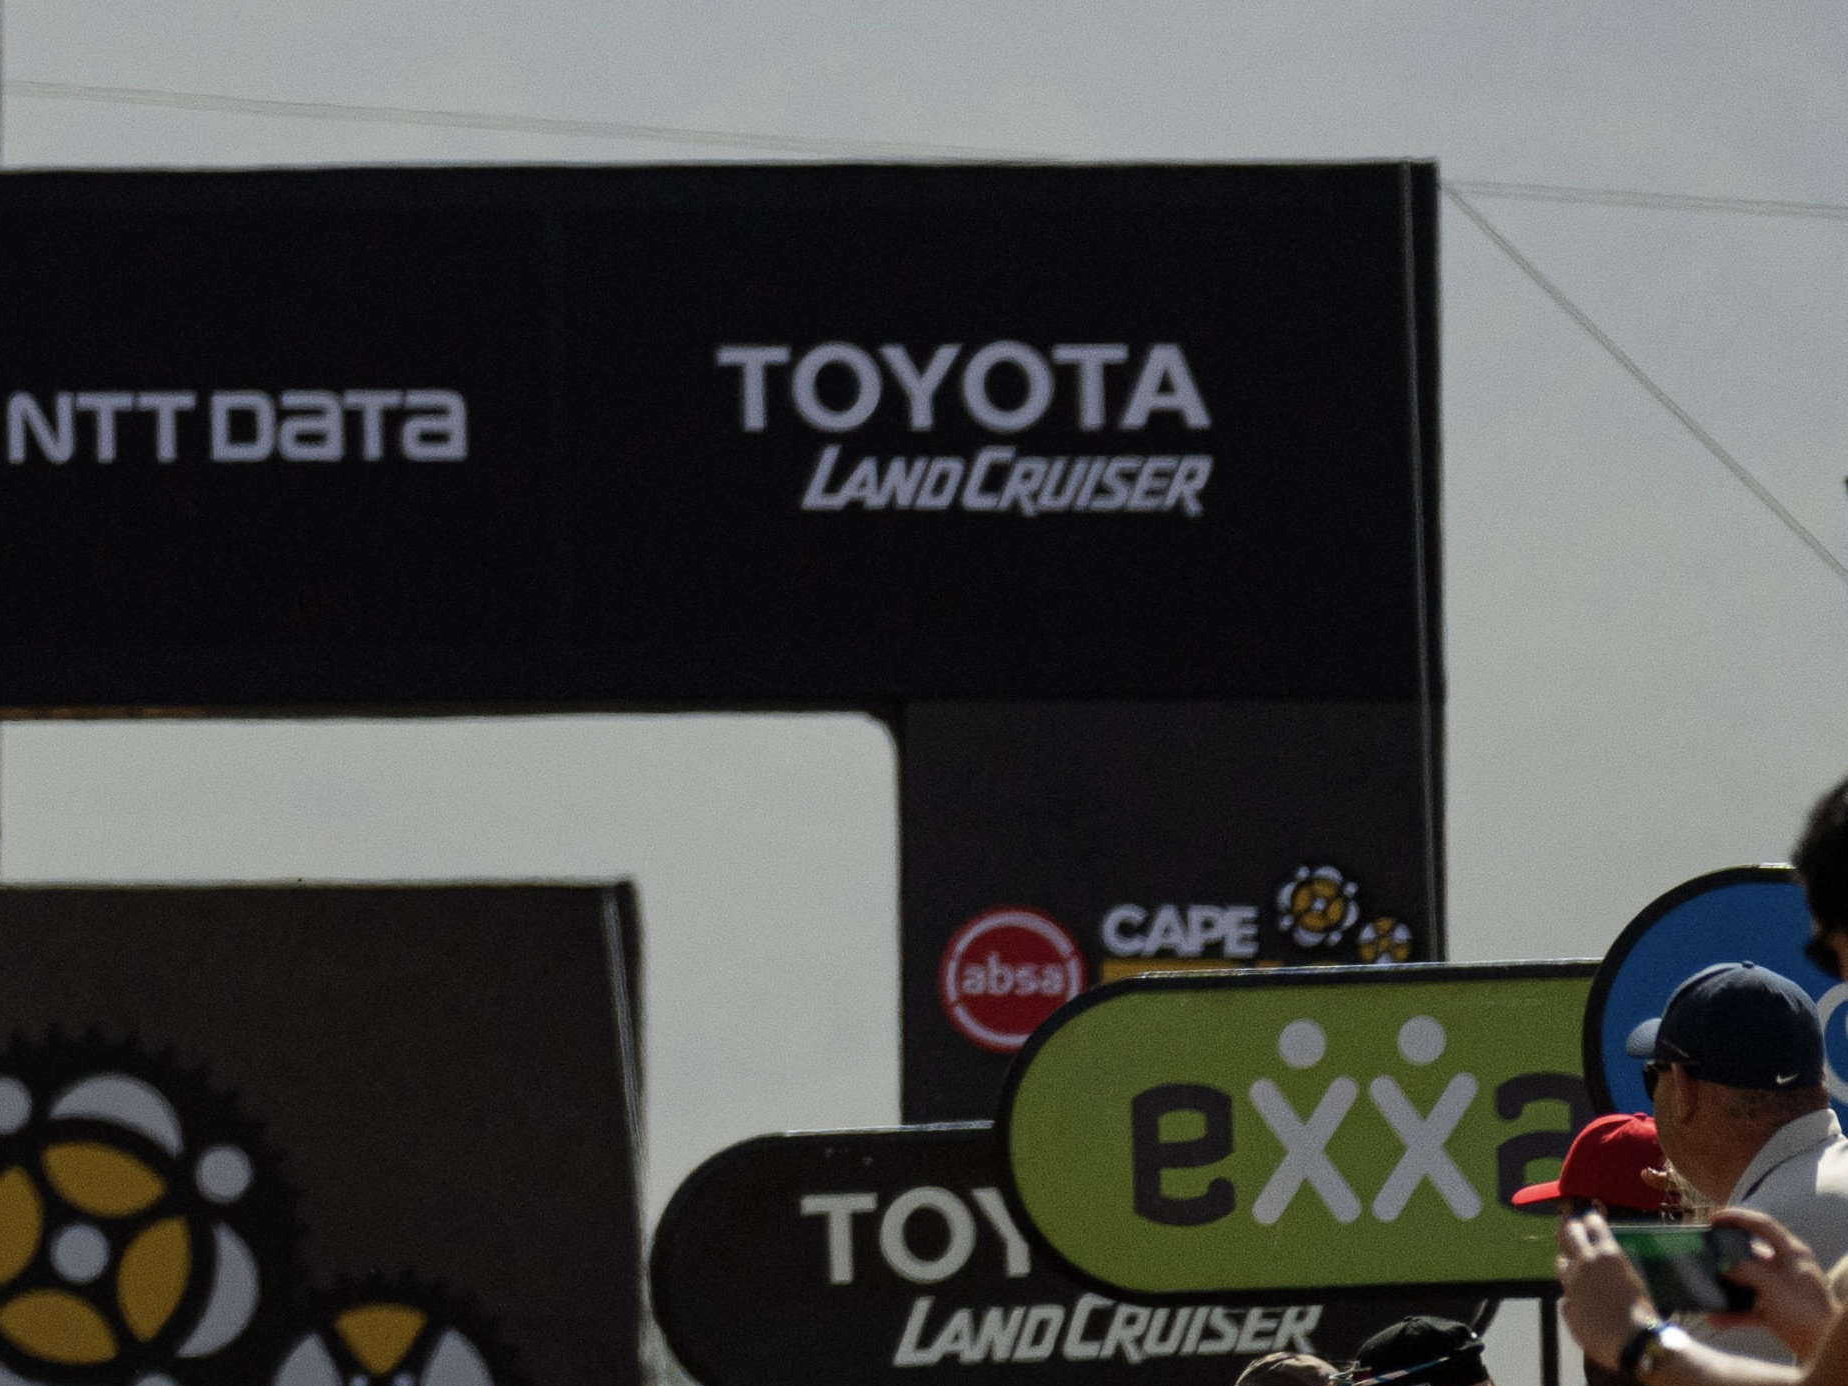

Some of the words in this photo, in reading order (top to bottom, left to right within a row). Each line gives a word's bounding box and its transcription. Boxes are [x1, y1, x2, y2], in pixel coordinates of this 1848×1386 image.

[716, 341, 1212, 433] TOYOTA
[6, 389, 196, 464] NTT
[1102, 903, 1260, 962] CAPE
[960, 952, 1071, 1002] absa
